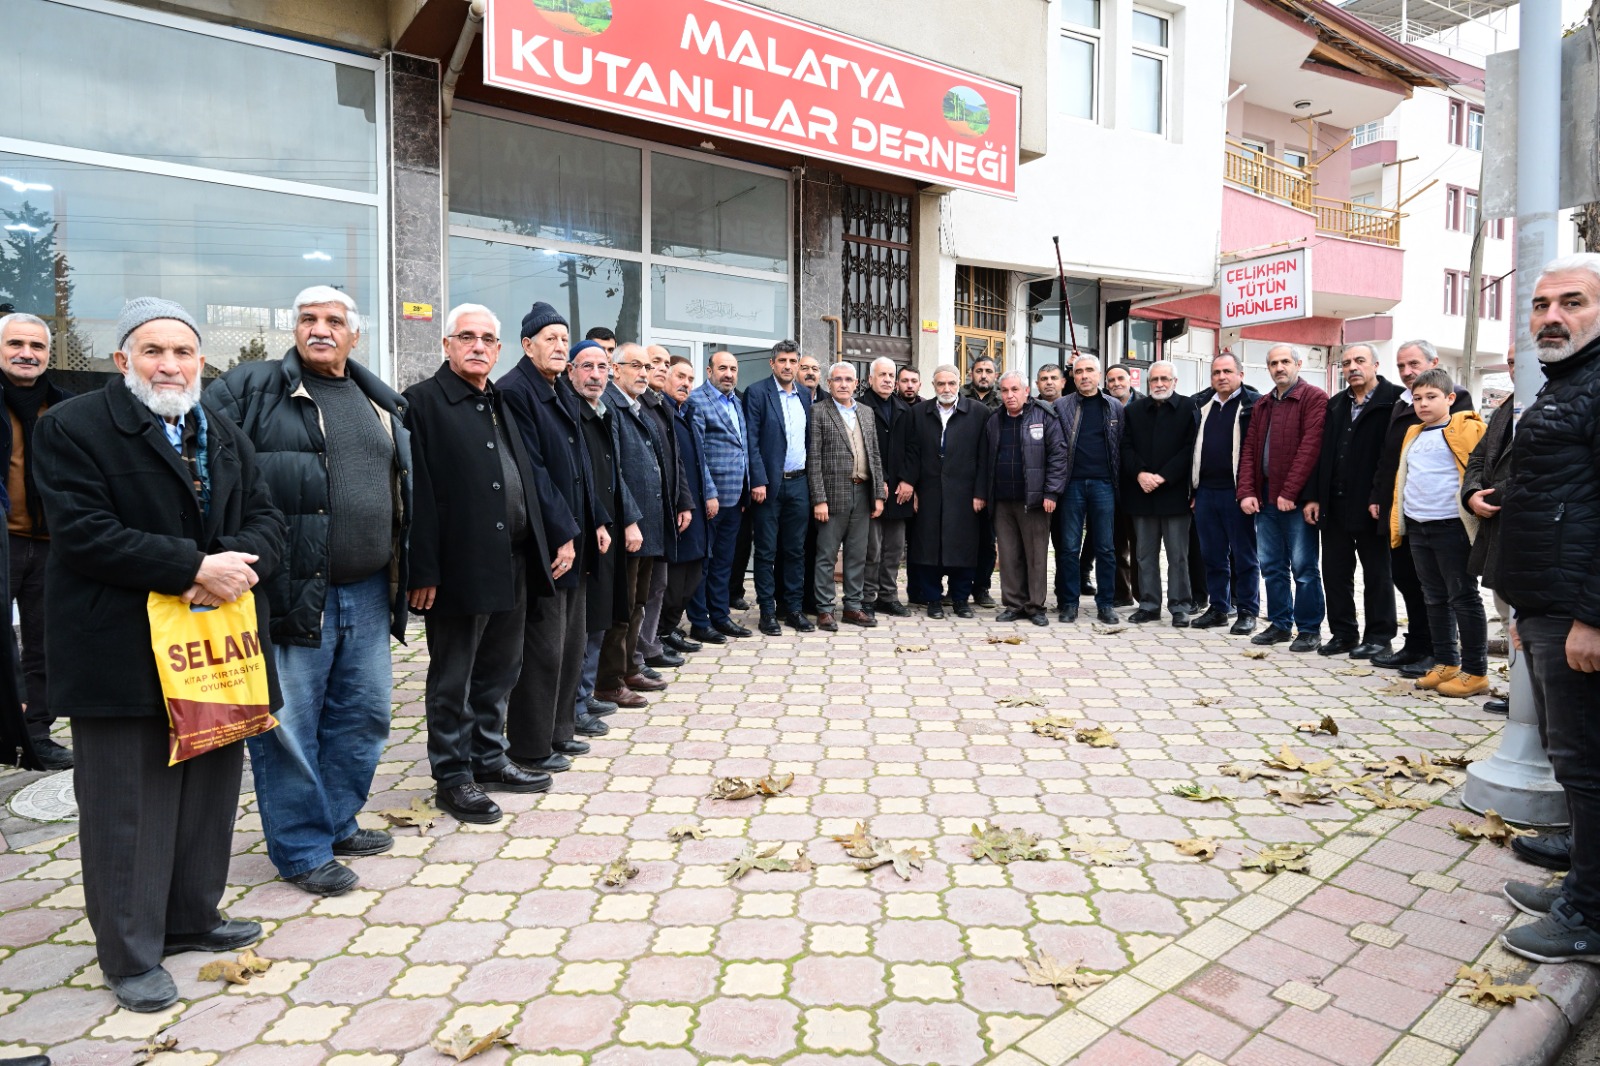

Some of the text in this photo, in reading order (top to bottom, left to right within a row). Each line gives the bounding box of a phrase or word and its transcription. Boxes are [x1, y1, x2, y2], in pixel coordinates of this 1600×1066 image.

[680, 13, 905, 109] MALATYA
[511, 29, 1007, 184] KUTANLILAR DERNEĞİ
[1226, 258, 1297, 284] ÇELİKHAN
[1237, 278, 1286, 299] TÜTÜN
[1226, 295, 1298, 318] ÜRÜNLERİ
[168, 630, 259, 673] SELAM
[211, 663, 260, 680] KIRTASİYE
[200, 678, 246, 692] OYUNCAK
